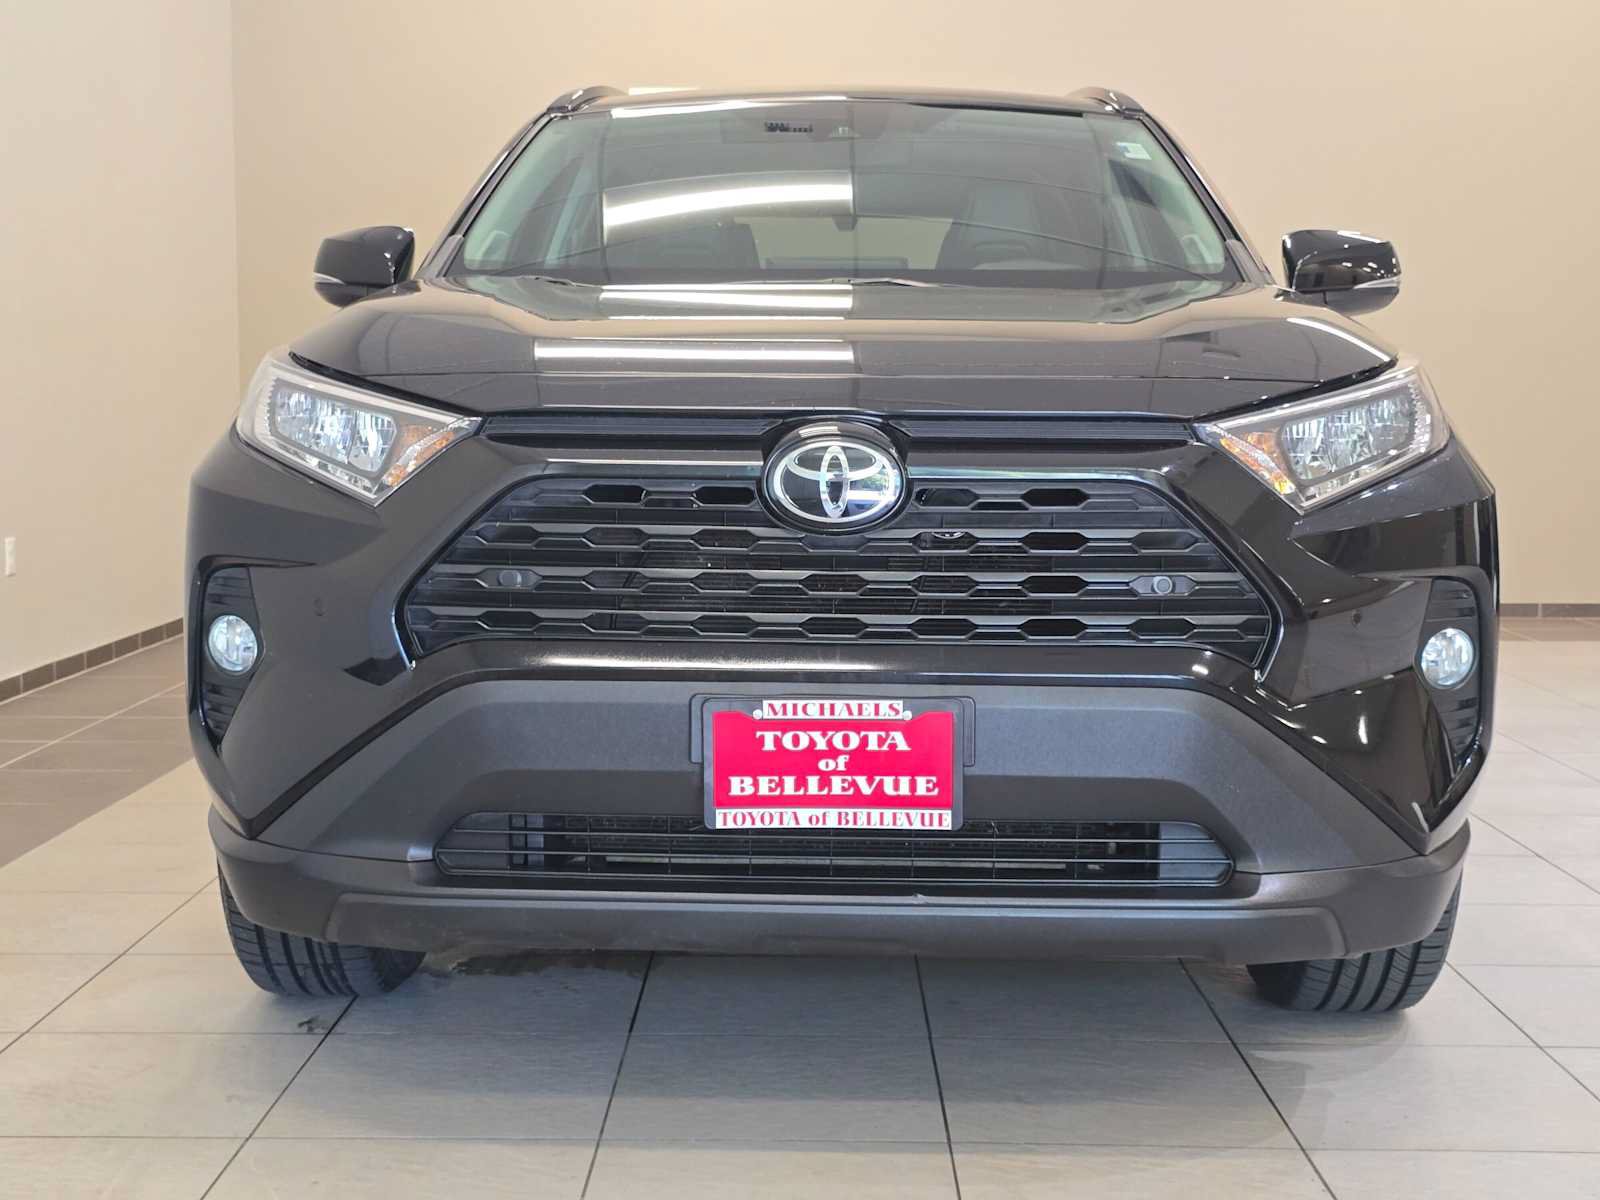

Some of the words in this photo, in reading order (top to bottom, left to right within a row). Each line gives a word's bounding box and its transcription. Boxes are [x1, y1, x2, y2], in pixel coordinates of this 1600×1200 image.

[766, 702, 901, 718] MICHAELS
[755, 731, 911, 751] TOYOTA
[817, 755, 849, 772] of
[728, 776, 939, 796] BELLEVUE
[718, 811, 800, 827] TOYOTA
[808, 811, 827, 827] of
[837, 811, 951, 828] BELLEVUE
